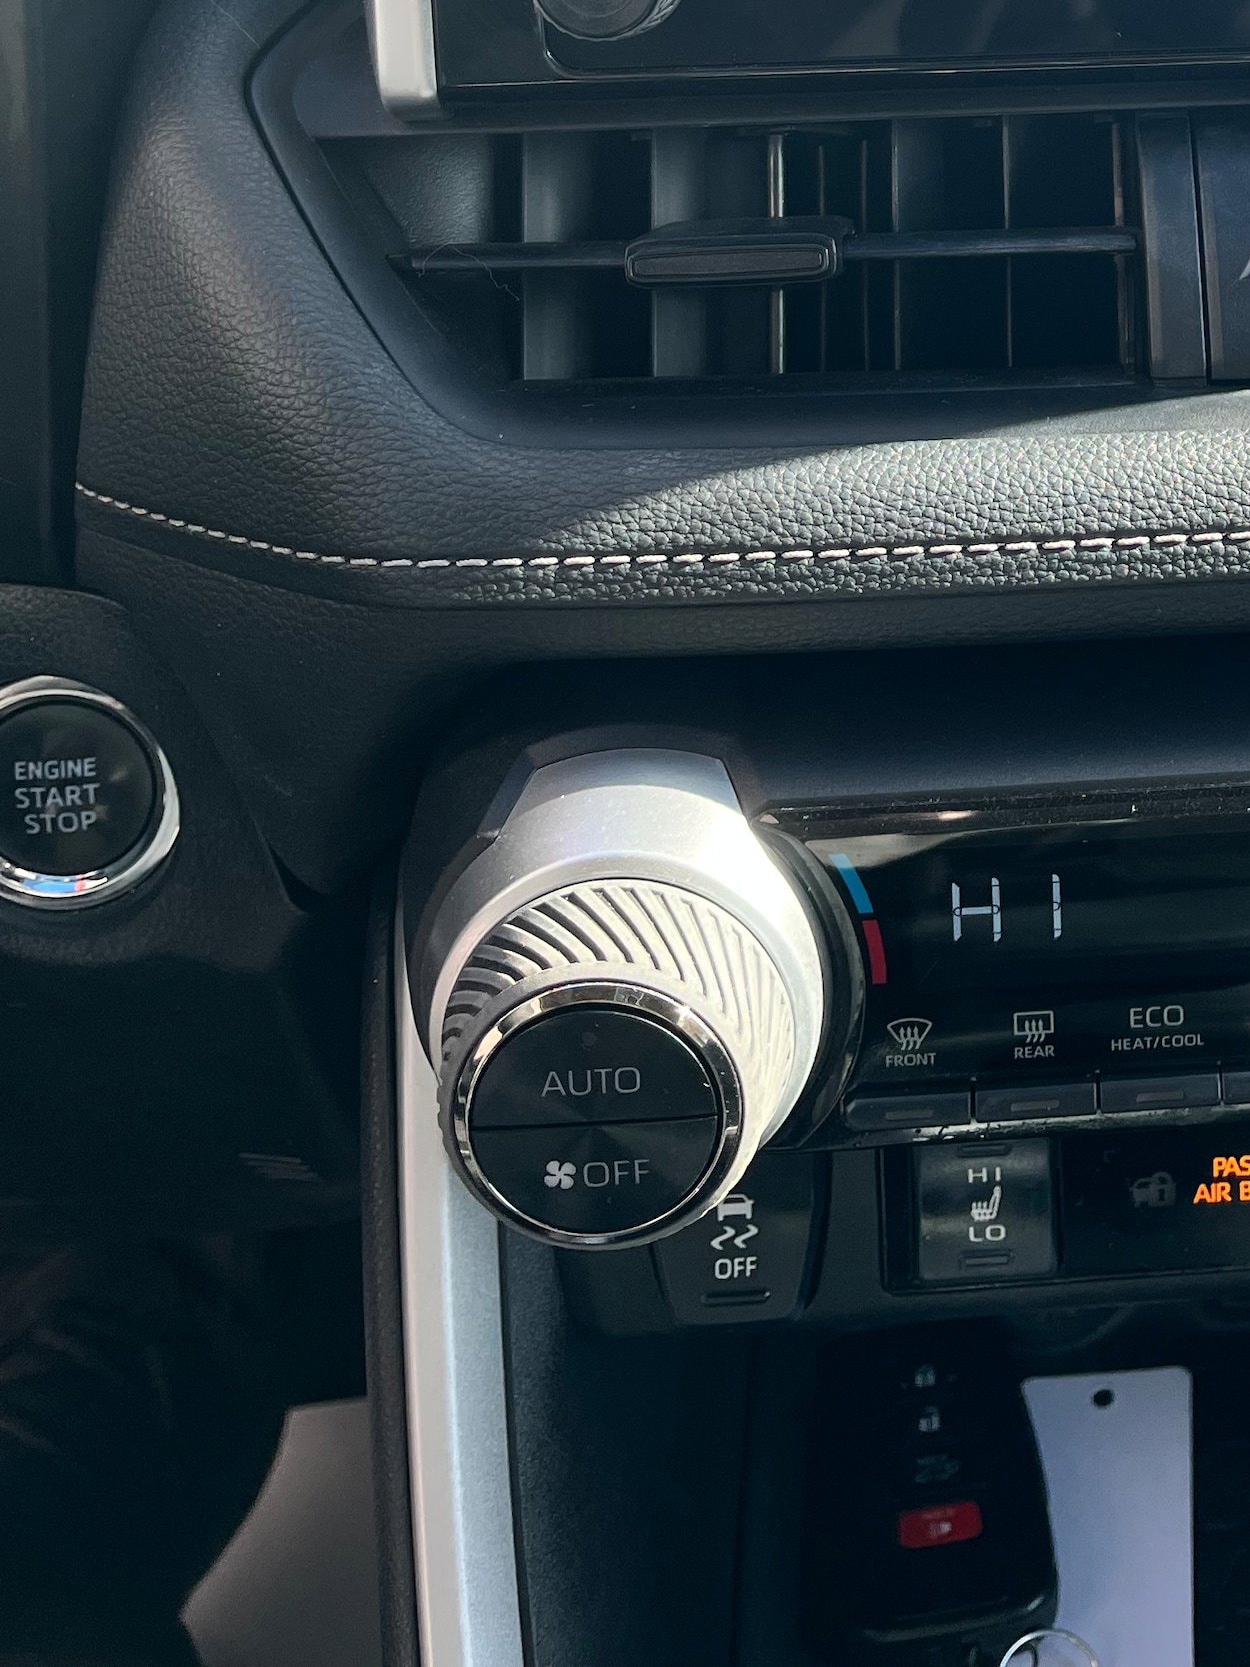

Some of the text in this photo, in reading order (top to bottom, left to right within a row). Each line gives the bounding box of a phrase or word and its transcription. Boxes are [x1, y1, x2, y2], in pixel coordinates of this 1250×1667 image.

[14, 758, 97, 780] ENGINE
[14, 784, 100, 809] START
[24, 811, 97, 834] STOP
[951, 873, 1062, 943] HI
[1129, 1004, 1184, 1029] ECO
[1013, 1044, 1055, 1060] REAR
[1111, 1033, 1205, 1052] HEAT/COOL
[885, 1052, 937, 1068] FRONT
[541, 1067, 641, 1097] AUTO
[583, 1159, 650, 1188] OFF
[967, 1166, 1001, 1184] HI
[1193, 1181, 1233, 1204] AIR
[968, 1224, 1006, 1243] LO
[714, 1256, 757, 1280] OFF
